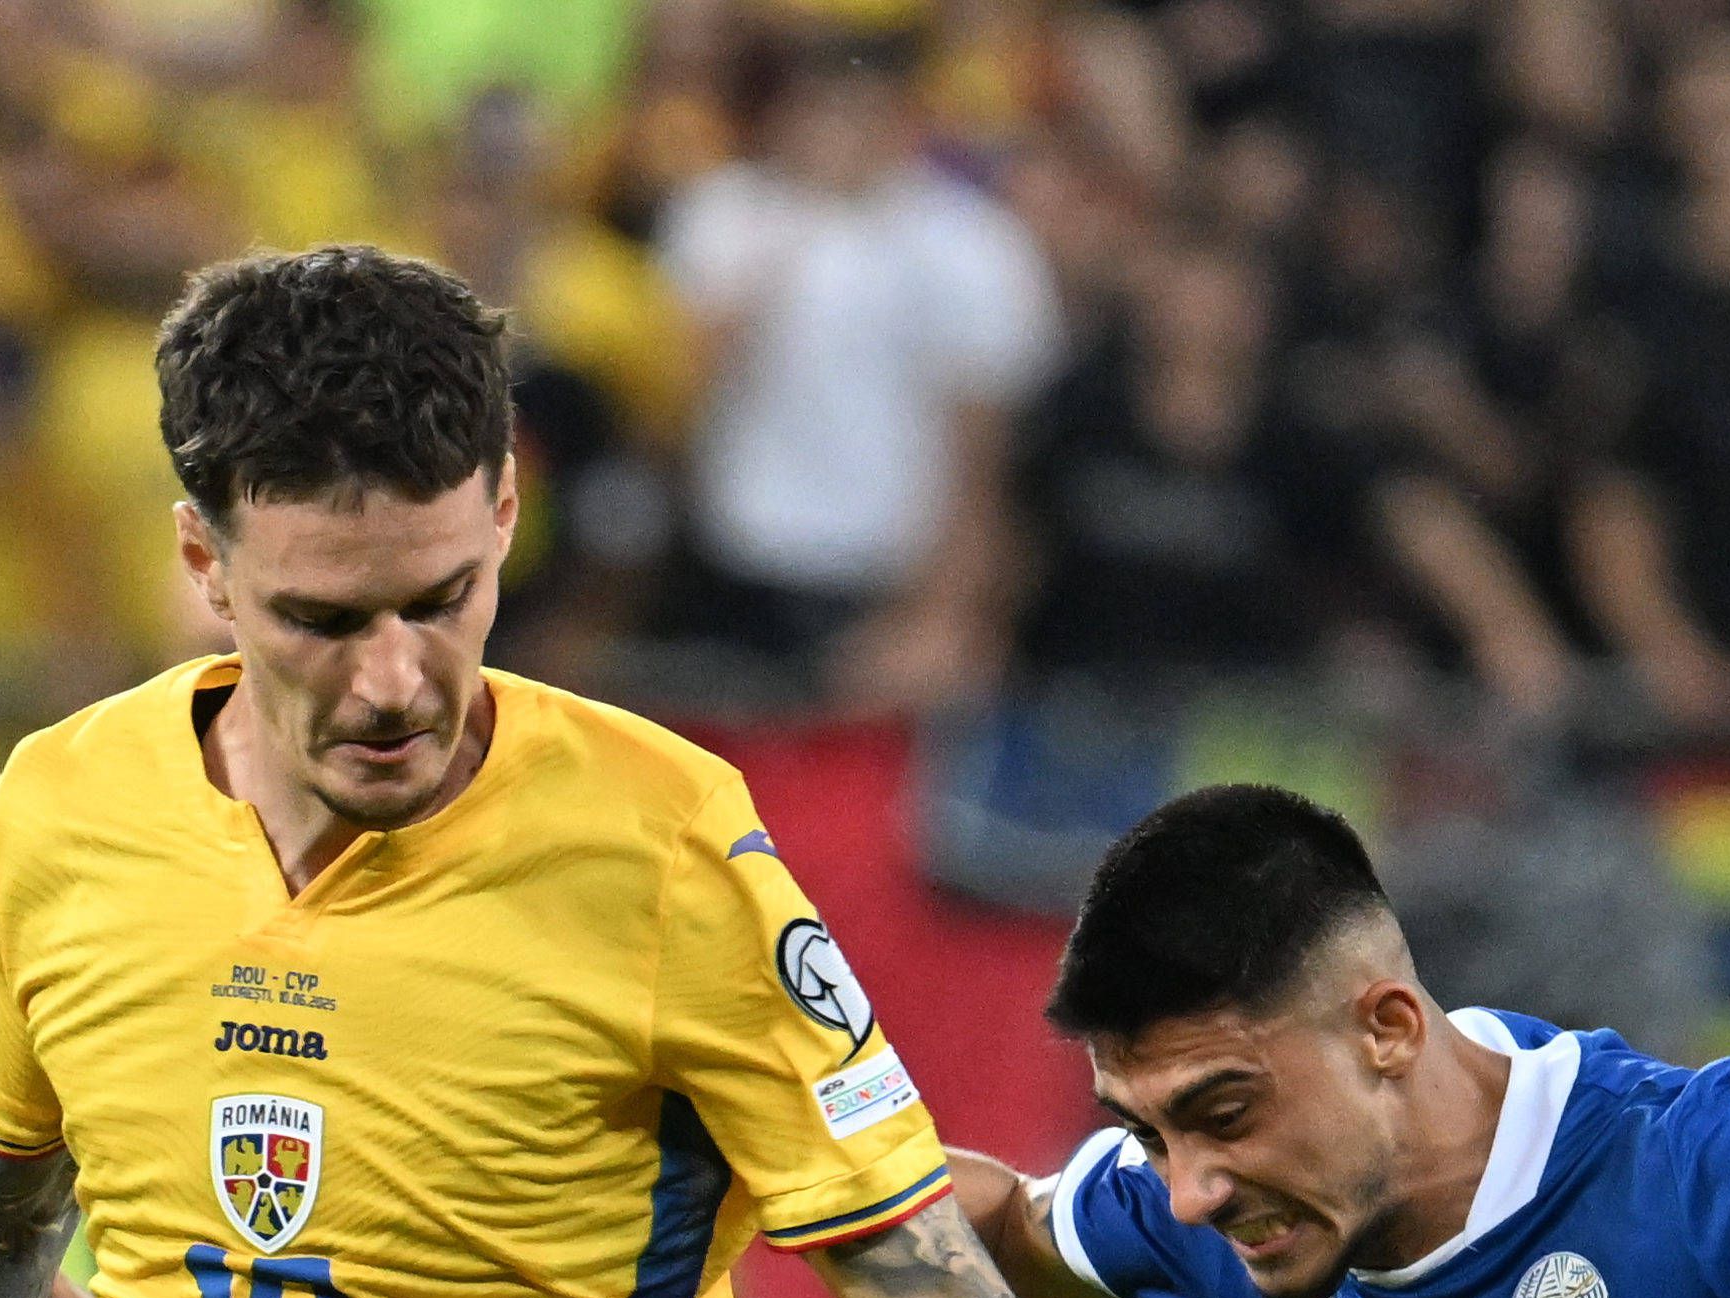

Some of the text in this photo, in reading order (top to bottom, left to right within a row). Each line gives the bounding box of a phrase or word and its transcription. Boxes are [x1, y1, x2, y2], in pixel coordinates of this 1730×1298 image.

[231, 965, 266, 985] ROU
[285, 971, 319, 992] CYP
[222, 1099, 311, 1133] ROMÂNIA
